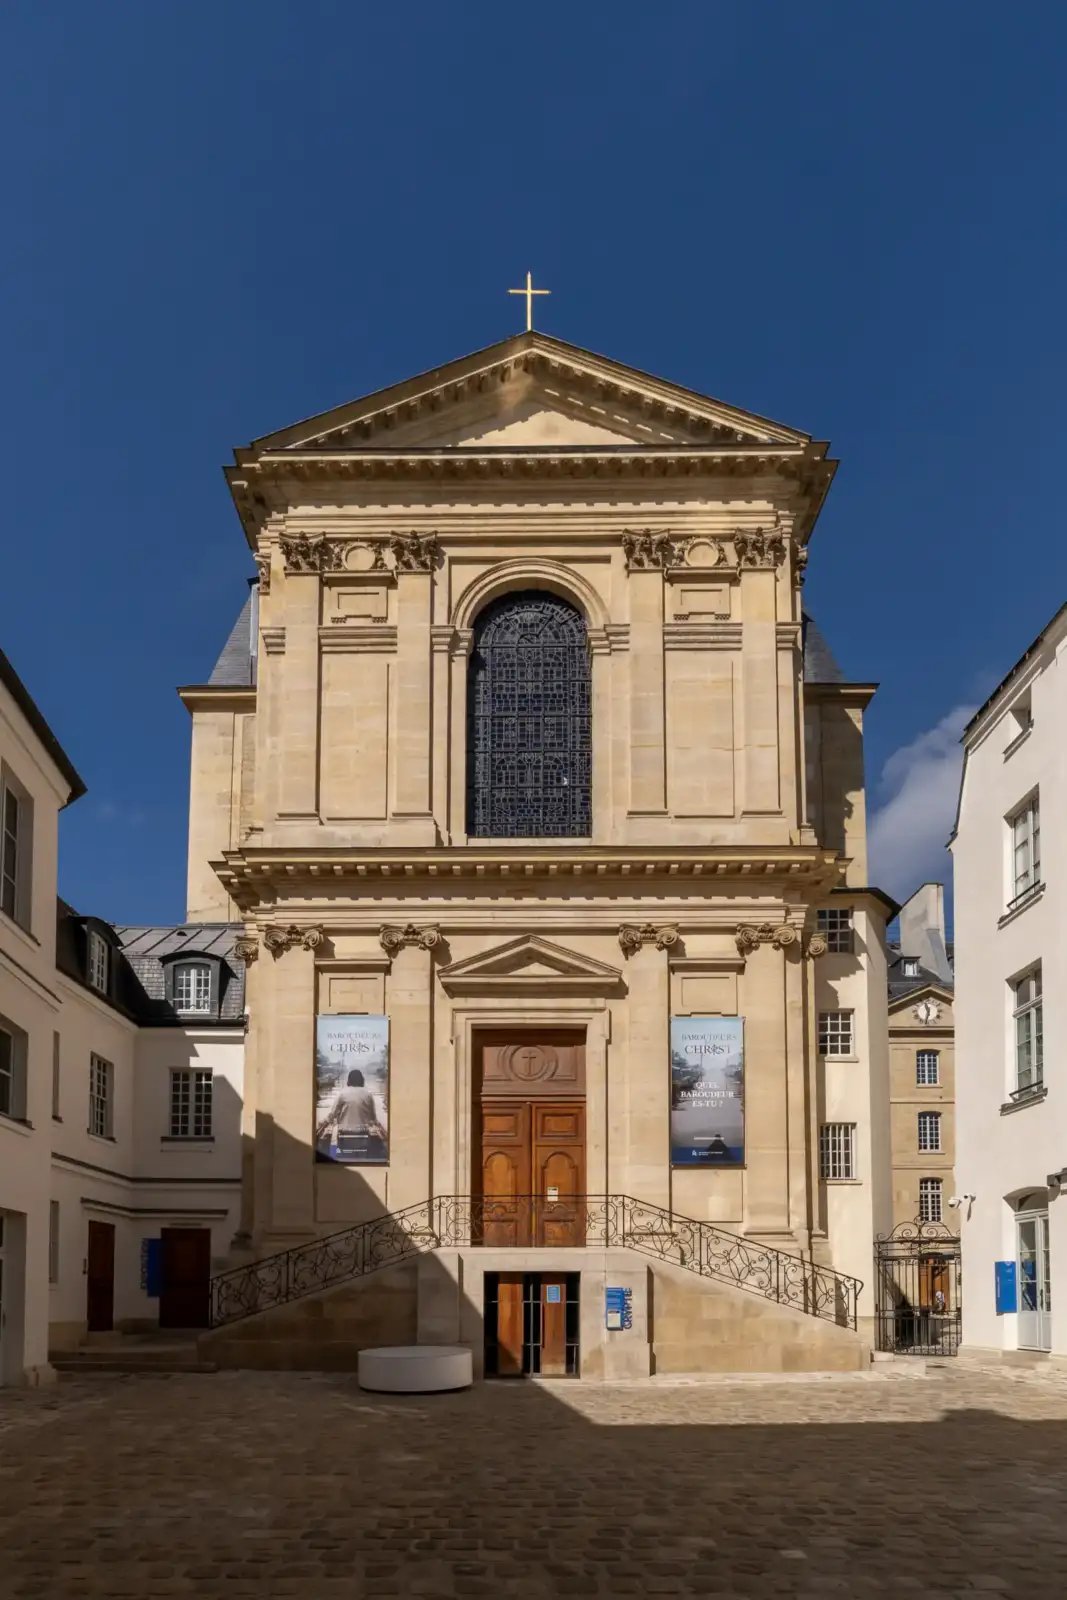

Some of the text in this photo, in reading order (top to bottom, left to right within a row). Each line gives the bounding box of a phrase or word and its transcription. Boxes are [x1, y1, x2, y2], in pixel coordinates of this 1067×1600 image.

[695, 1081, 720, 1090] QUEL
[680, 1090, 735, 1098] BAROUDEUR
[623, 1287, 633, 1330] CRYPTE
